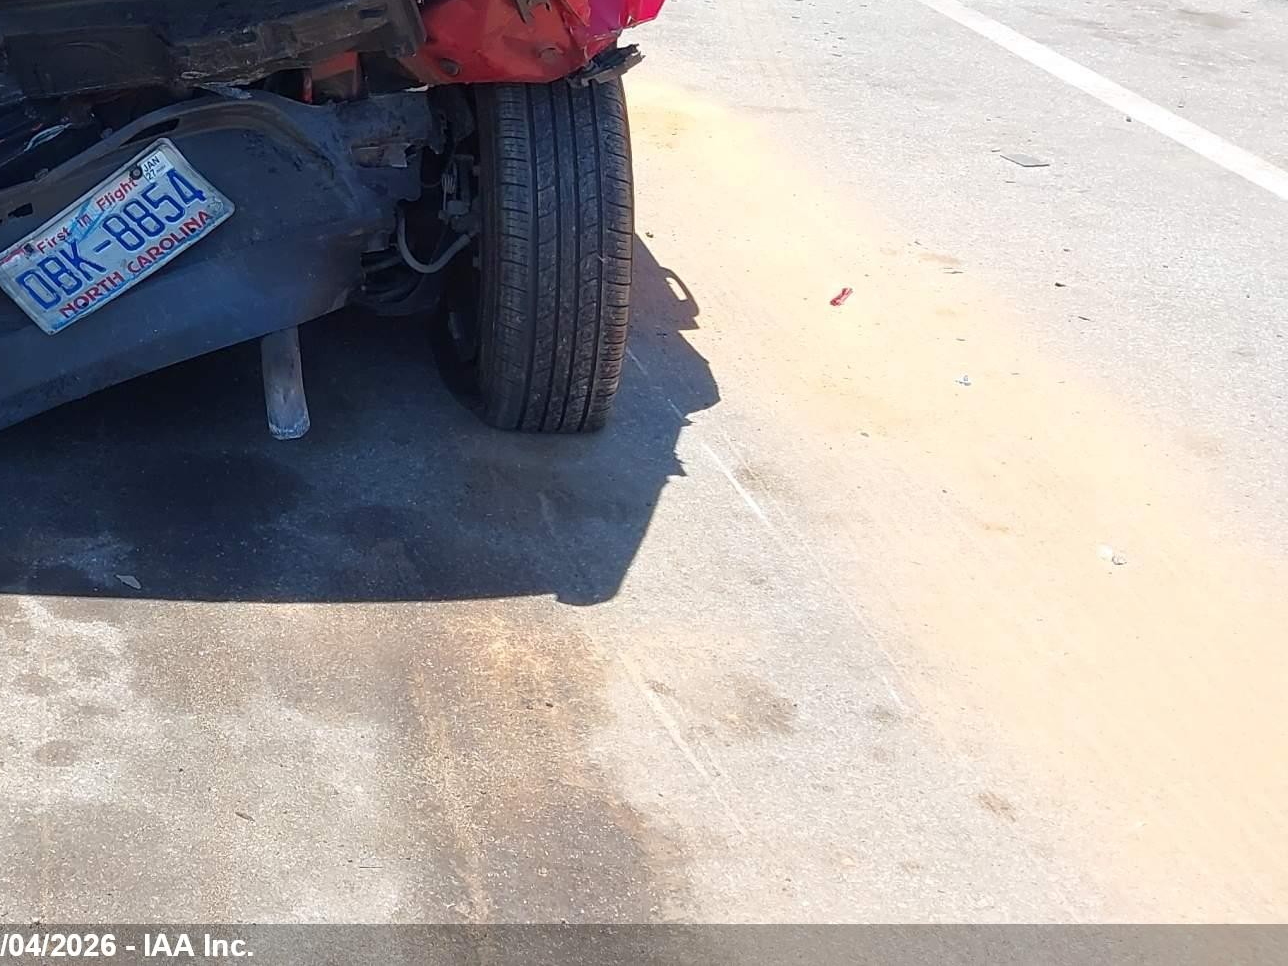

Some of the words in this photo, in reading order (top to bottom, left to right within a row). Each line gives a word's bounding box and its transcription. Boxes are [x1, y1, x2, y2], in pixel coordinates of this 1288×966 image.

[143, 155, 161, 173] JAN
[145, 168, 157, 180] 27
[14, 168, 208, 311] DBK-8854
[37, 226, 73, 254] First
[75, 213, 92, 229] in
[95, 177, 139, 212] Flight
[58, 271, 125, 319] NORTH
[127, 210, 212, 274] CAROLINA
